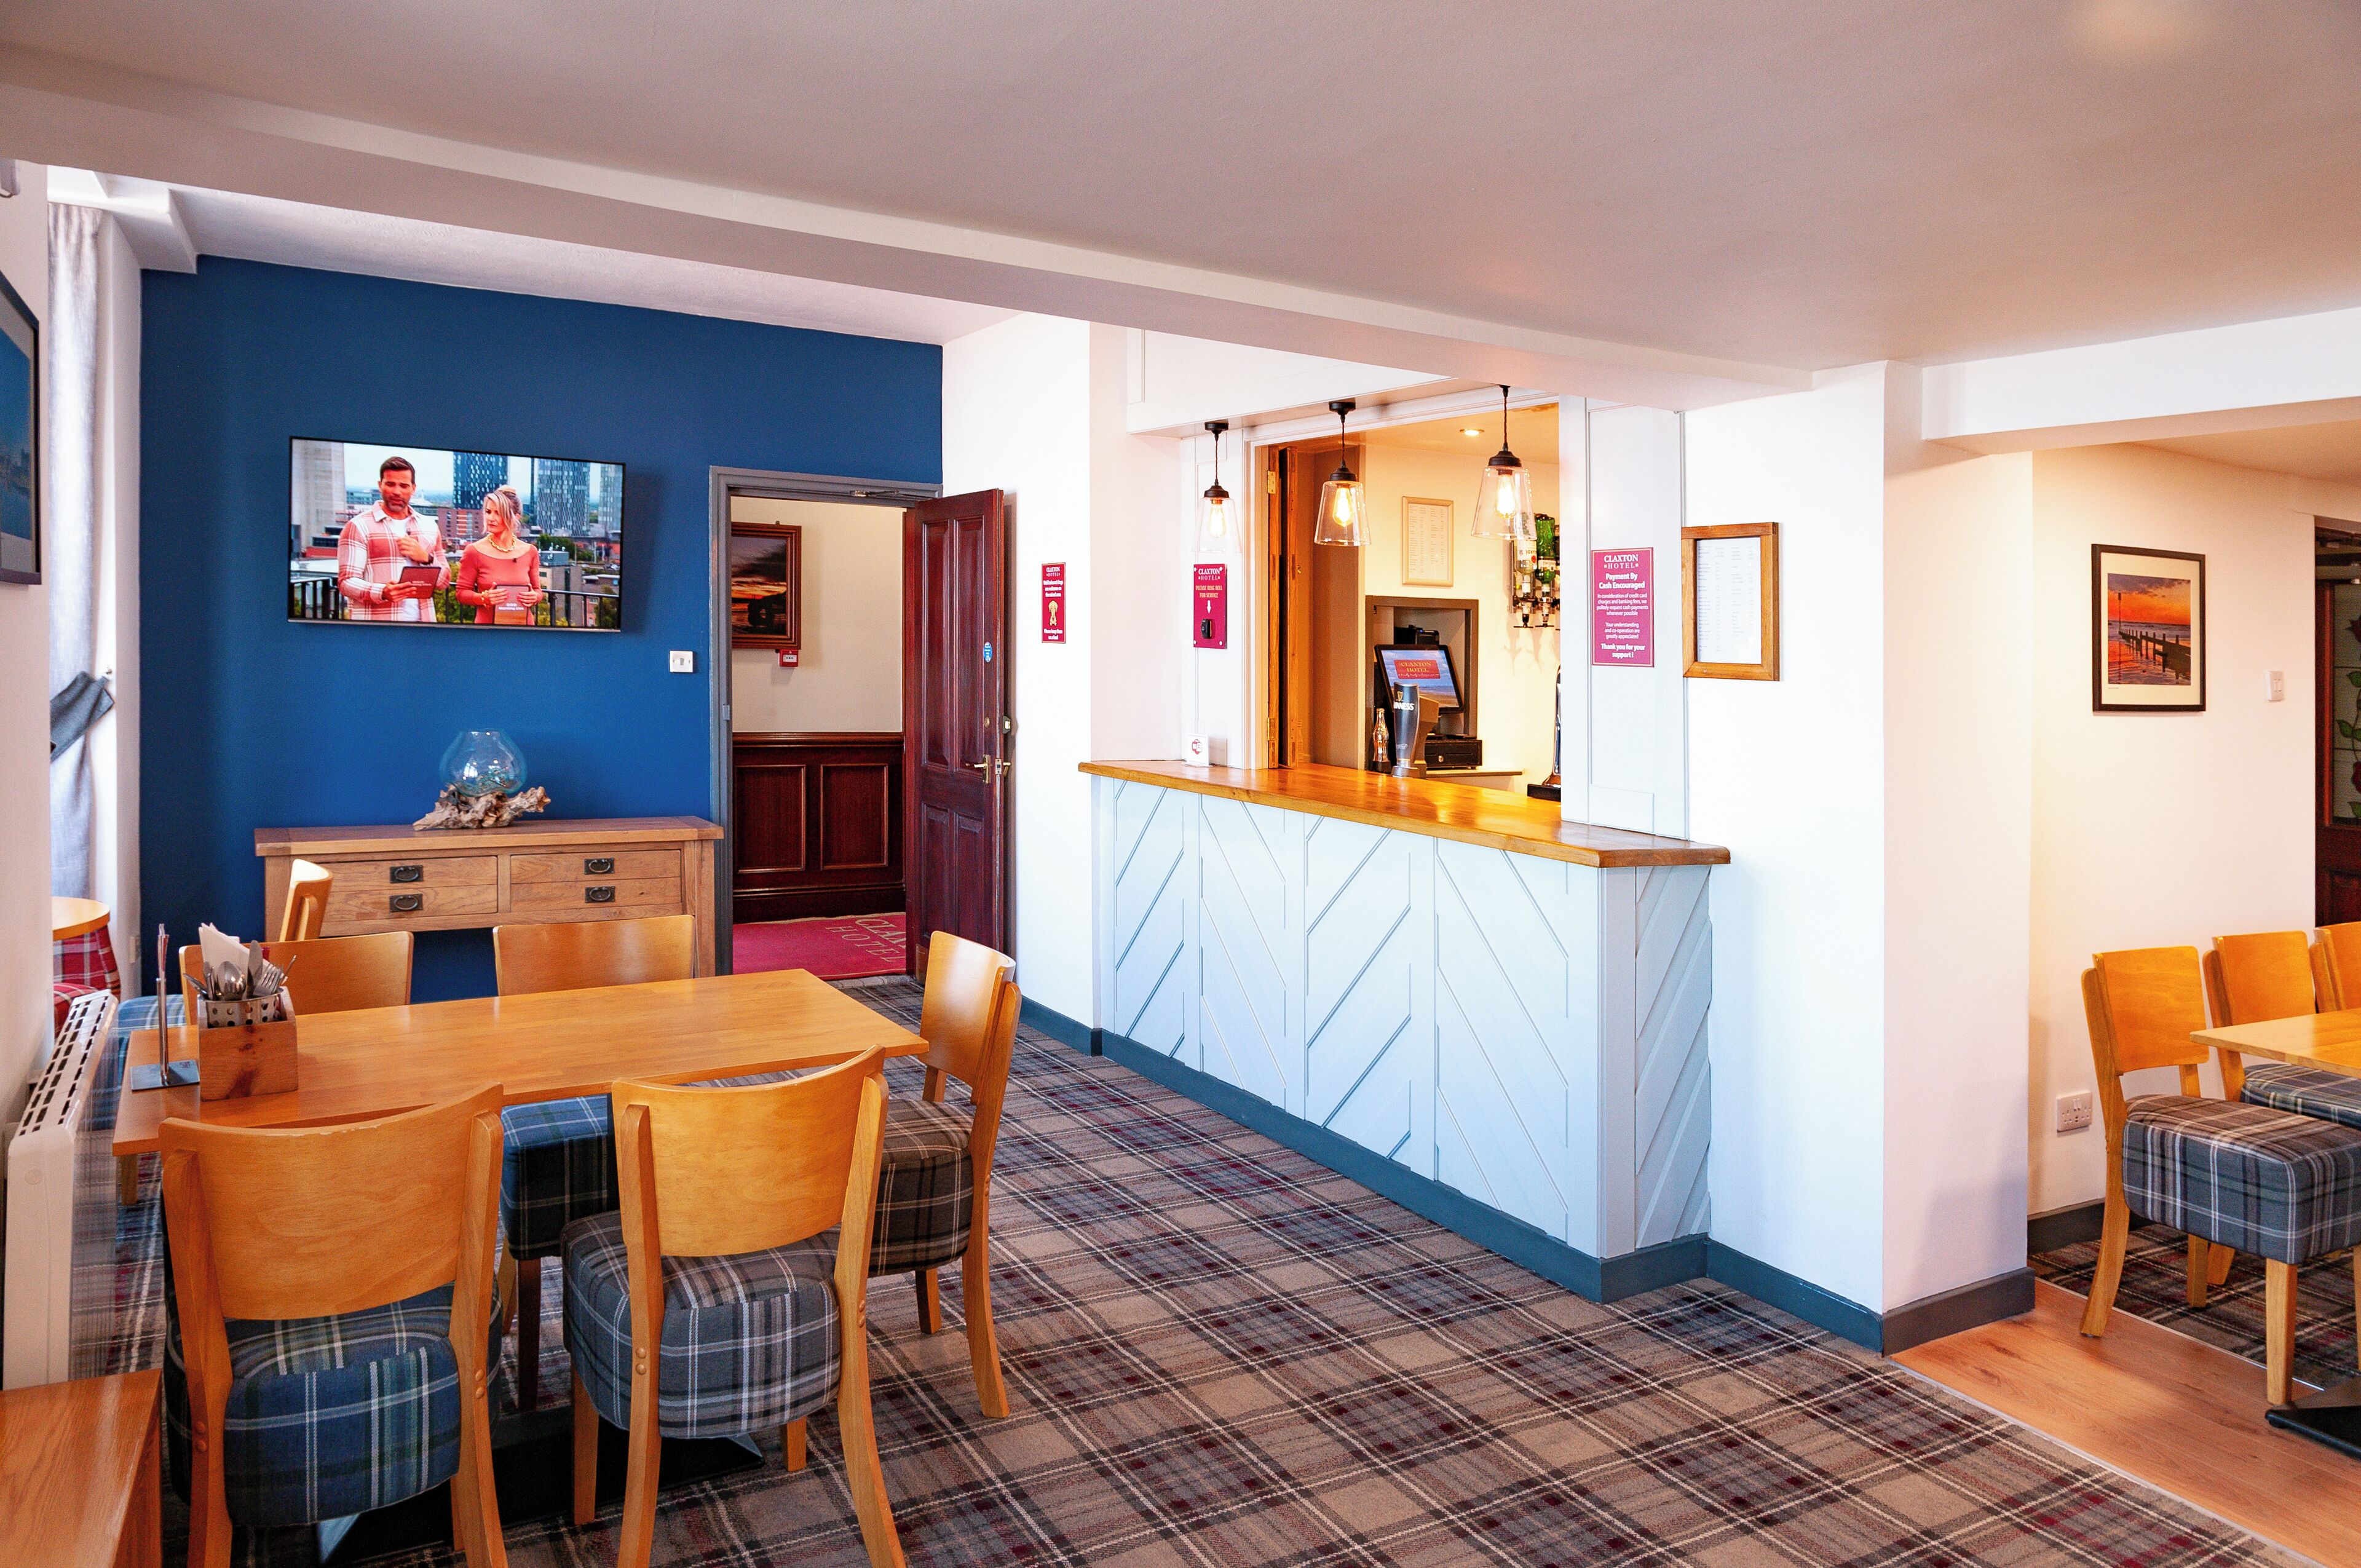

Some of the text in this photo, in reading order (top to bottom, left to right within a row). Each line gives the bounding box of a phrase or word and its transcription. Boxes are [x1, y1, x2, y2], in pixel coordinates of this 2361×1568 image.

[1604, 554, 1638, 563] CLAXTON
[1613, 581, 1645, 590] Encouraged
[825, 925, 906, 962] HOTEL
